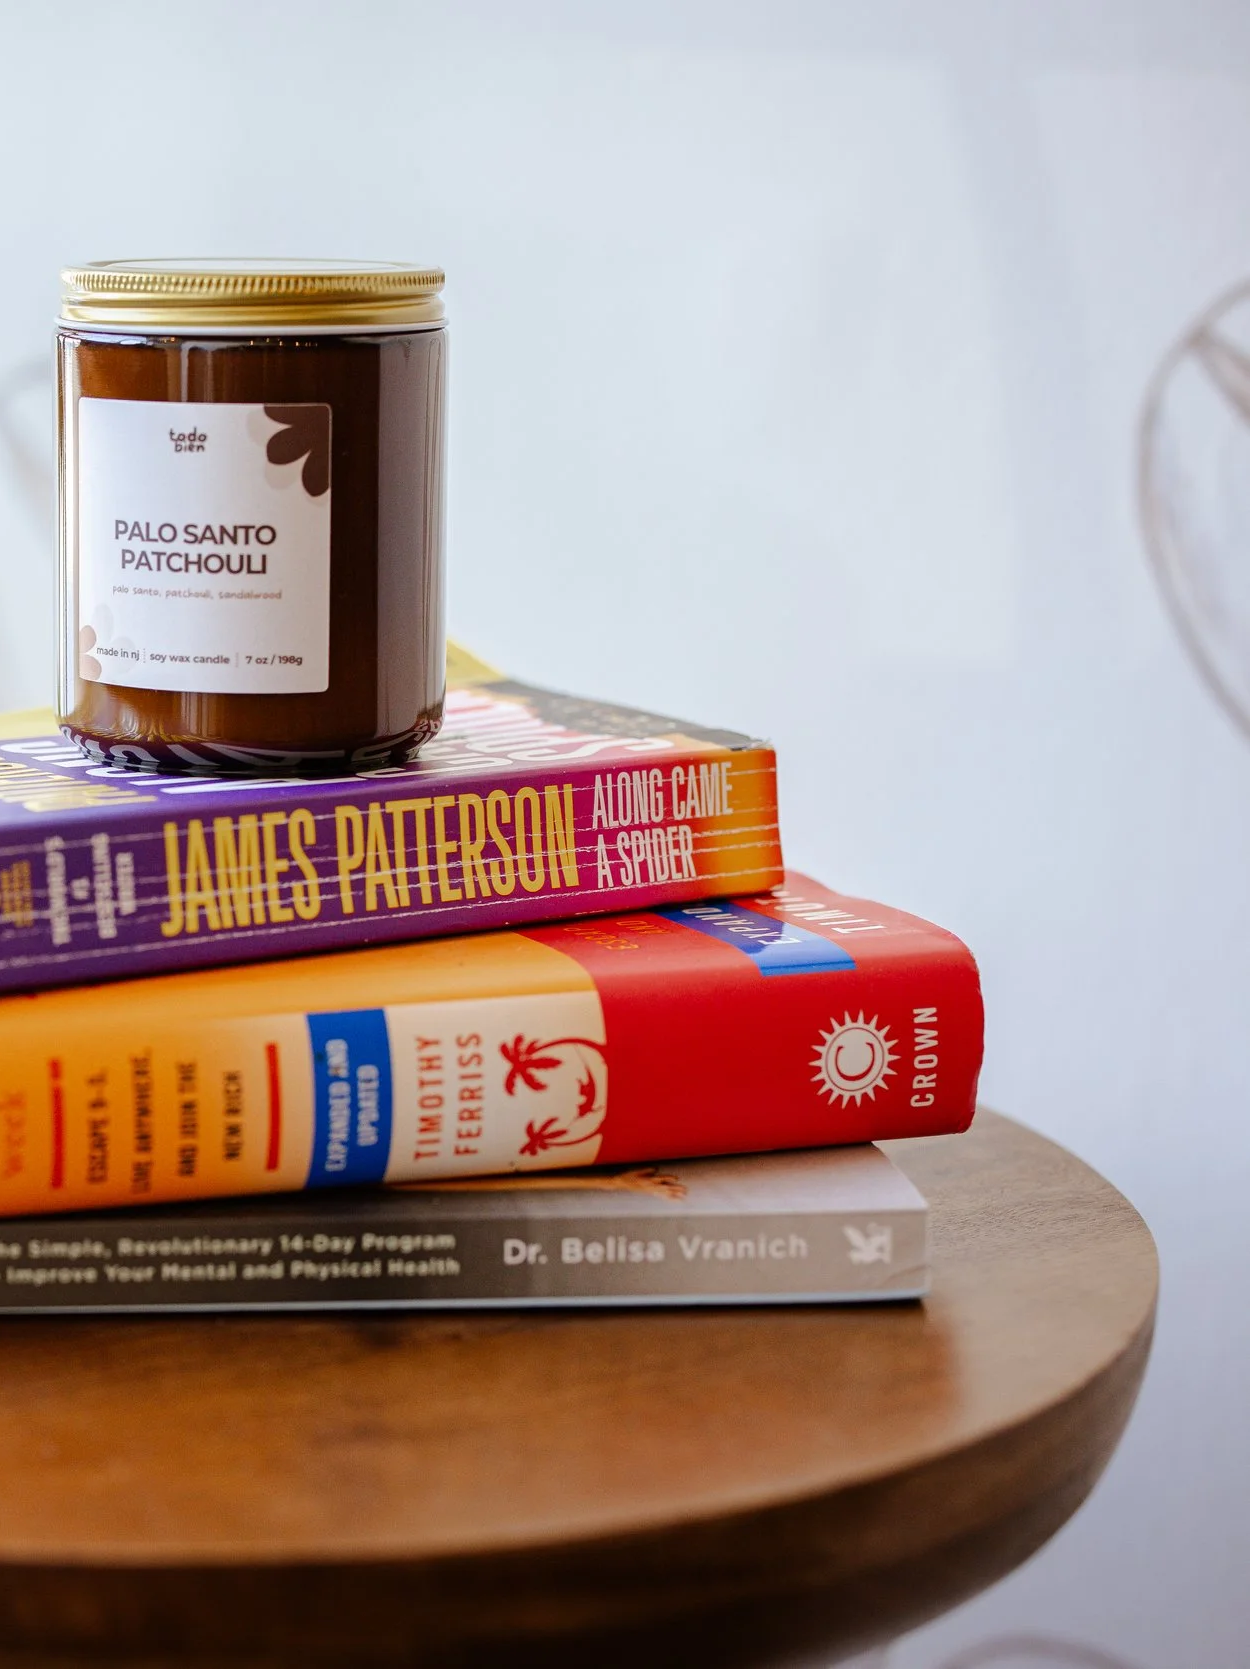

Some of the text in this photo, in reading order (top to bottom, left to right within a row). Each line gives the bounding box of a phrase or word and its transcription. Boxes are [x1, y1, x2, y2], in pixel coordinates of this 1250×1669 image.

[169, 427, 207, 442] todo
[174, 441, 205, 453] bien
[114, 519, 277, 545] PALO SANTO
[121, 549, 267, 574] PATCHOULI
[112, 585, 129, 595] palo
[132, 587, 162, 597] santo,
[218, 589, 283, 600] sandalwood
[96, 647, 119, 657] made
[120, 648, 129, 658] in
[131, 650, 140, 661] nj
[149, 653, 167, 663] soy
[169, 655, 191, 663] wax
[193, 655, 230, 664] candle
[245, 656, 253, 664] 7
[278, 656, 303, 666] 198g
[592, 762, 733, 829] ALONG CAME
[161, 808, 321, 937] JAMES
[336, 783, 580, 914] PATTERSON
[597, 824, 697, 889] A SPIDER
[562, 927, 639, 950] ESCAP
[614, 919, 668, 936] AND
[910, 1007, 938, 1107] CROWN
[325, 1039, 350, 1172] EXPANDED AND
[356, 1064, 379, 1146] UPDATED
[414, 1036, 443, 1161] TIMOTHY
[454, 1033, 483, 1155] FERRISS
[177, 1062, 197, 1177] AND JOIN THE
[224, 1071, 242, 1161] NEW RICH
[87, 1119, 107, 1184] ESCAPE
[132, 1161, 151, 1194] LIVE
[28, 1238, 112, 1260] Simple,
[117, 1235, 273, 1256] Revolutionary
[279, 1234, 355, 1254] 14-Day
[362, 1233, 456, 1254] Program
[503, 1233, 809, 1265] Dr. Belisa Vranich
[104, 1264, 155, 1282] Your
[161, 1261, 236, 1281] Mental
[242, 1260, 284, 1280] and
[290, 1259, 382, 1281] Physical
[387, 1257, 461, 1277] Health
